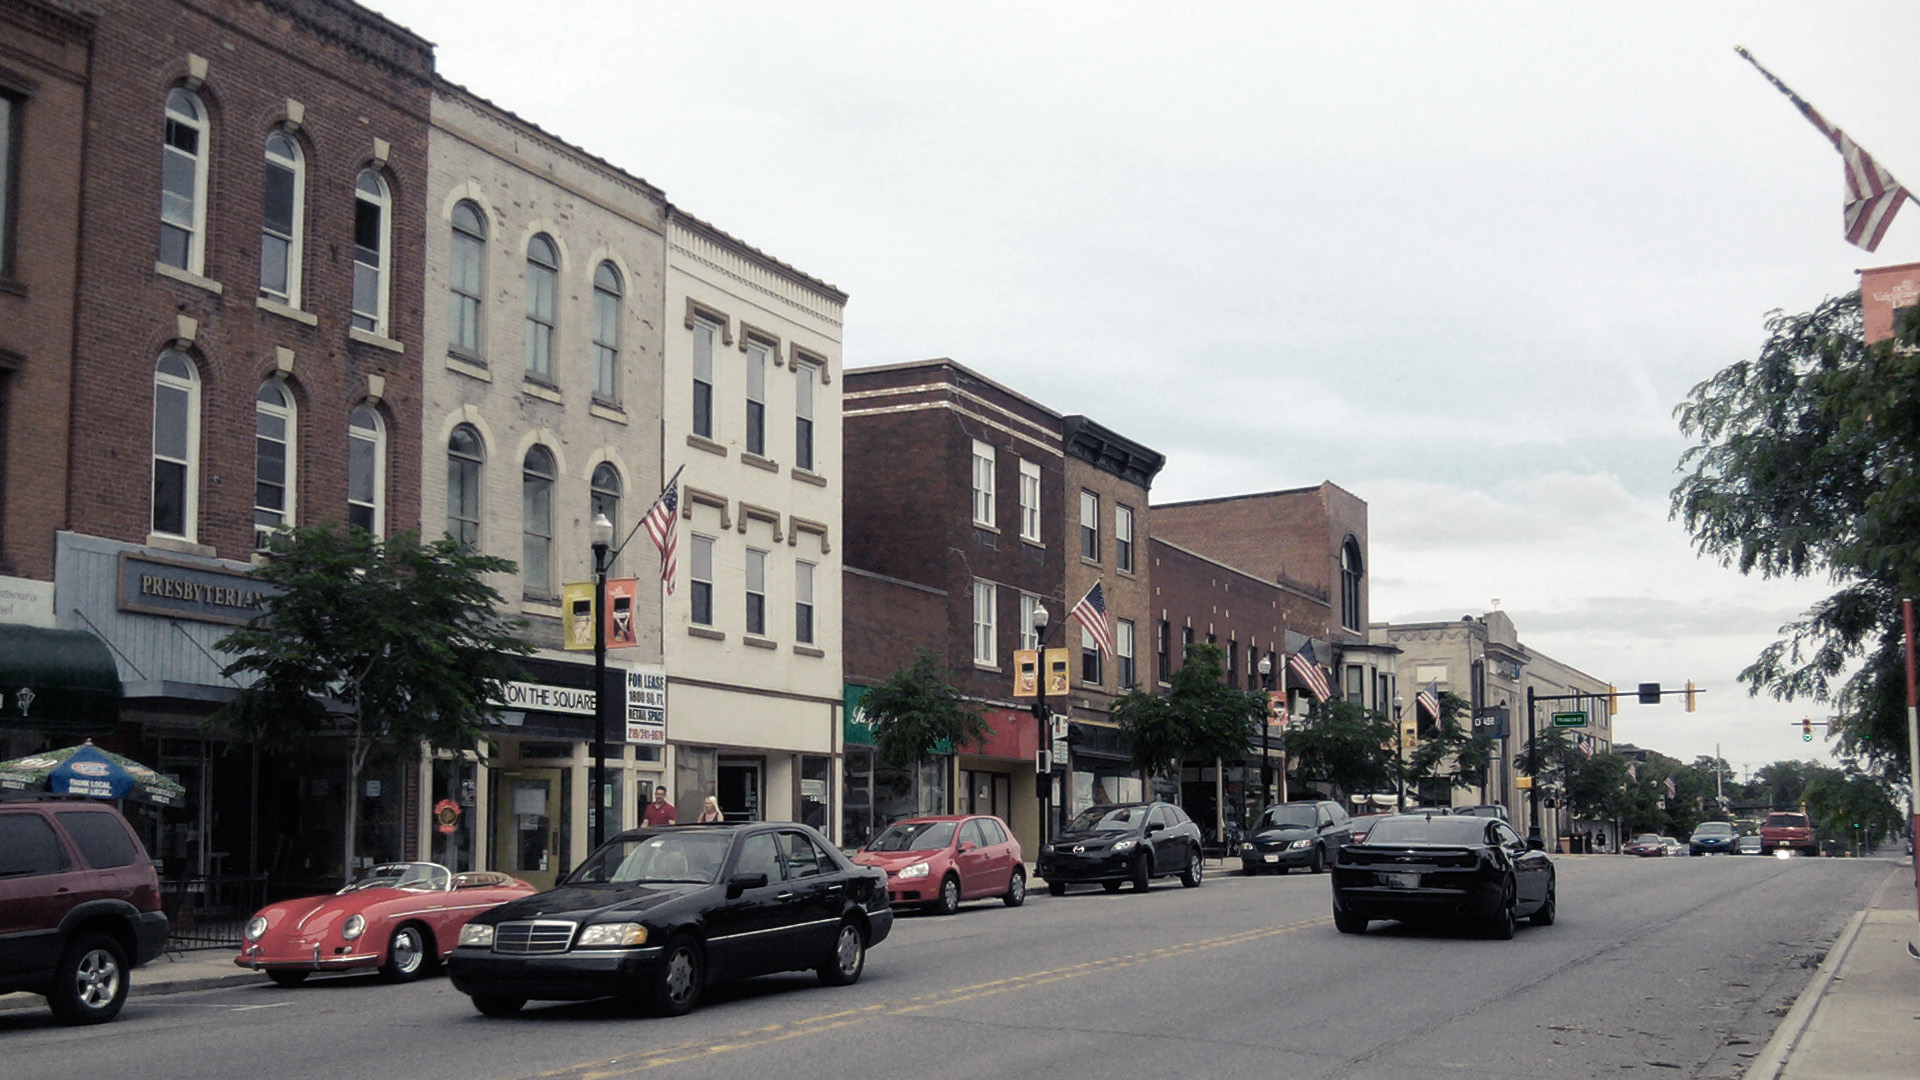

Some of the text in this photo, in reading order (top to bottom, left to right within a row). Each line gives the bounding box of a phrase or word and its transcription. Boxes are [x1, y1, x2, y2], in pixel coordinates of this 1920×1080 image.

[142, 575, 264, 611] PRESBYTERIAN
[629, 673, 664, 690] FOR LEASE
[508, 686, 527, 703] ON
[528, 687, 550, 706] THE
[553, 690, 596, 710] SQUARE
[629, 709, 664, 722] RETAIL SPACE
